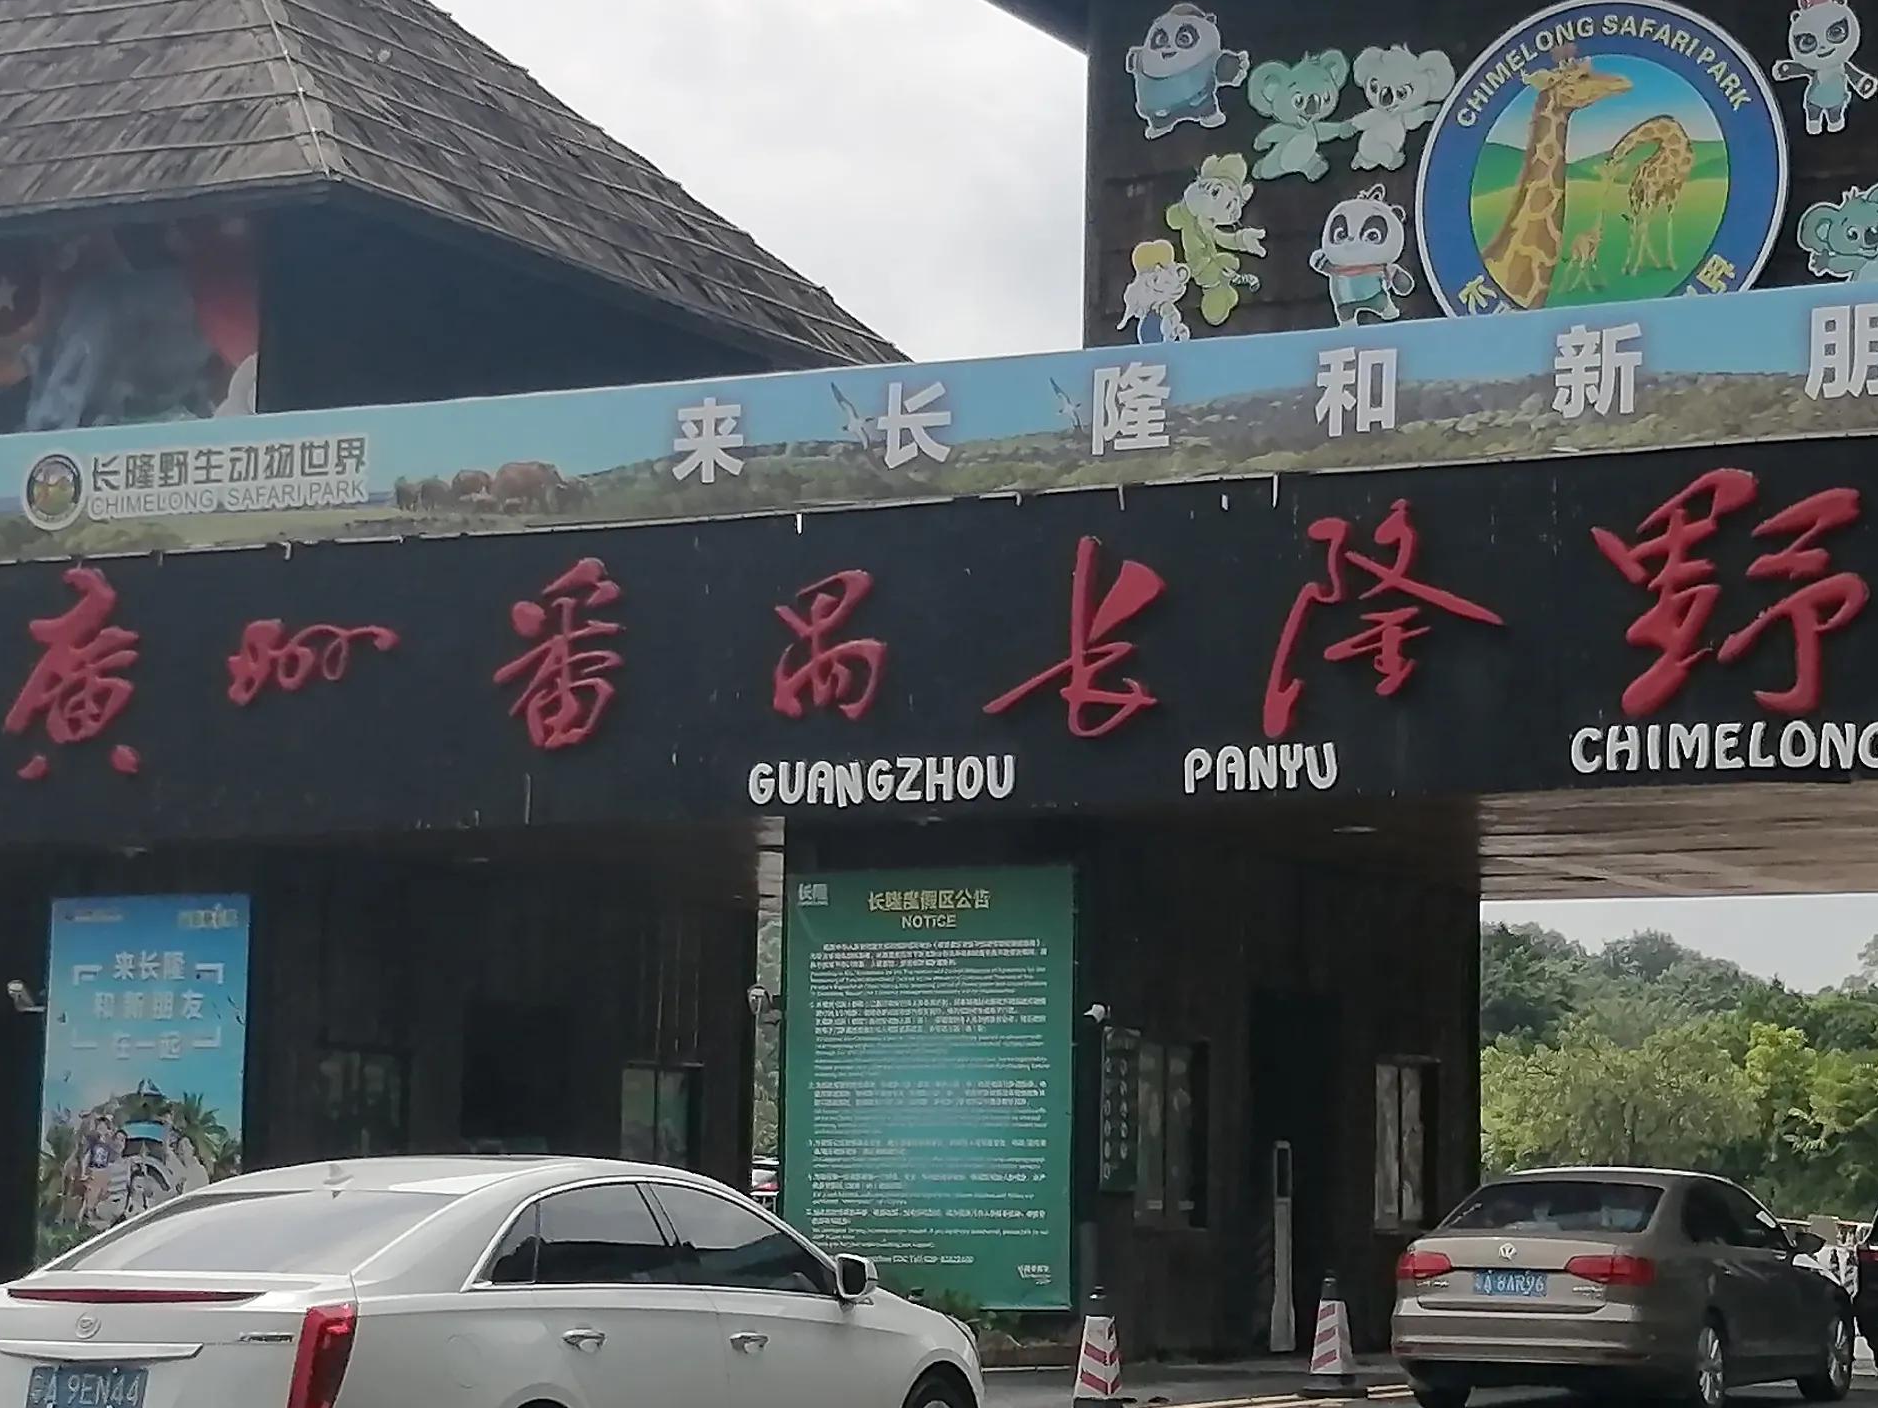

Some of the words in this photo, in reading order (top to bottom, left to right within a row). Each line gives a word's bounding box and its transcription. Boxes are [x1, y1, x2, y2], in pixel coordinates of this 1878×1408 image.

[1456, 16, 1595, 128] CHIMELONG
[1602, 15, 1701, 57] SAFARI
[1697, 48, 1753, 111] PARK
[92, 437, 366, 492] 长隆野生动物世界
[91, 489, 213, 516] CHIMELONG
[227, 484, 300, 506] SAFARI
[310, 479, 366, 501] PARK
[748, 754, 1016, 807] GUANGZHOU
[1184, 742, 1338, 792] PANYU
[901, 914, 958, 929] NOTICE
